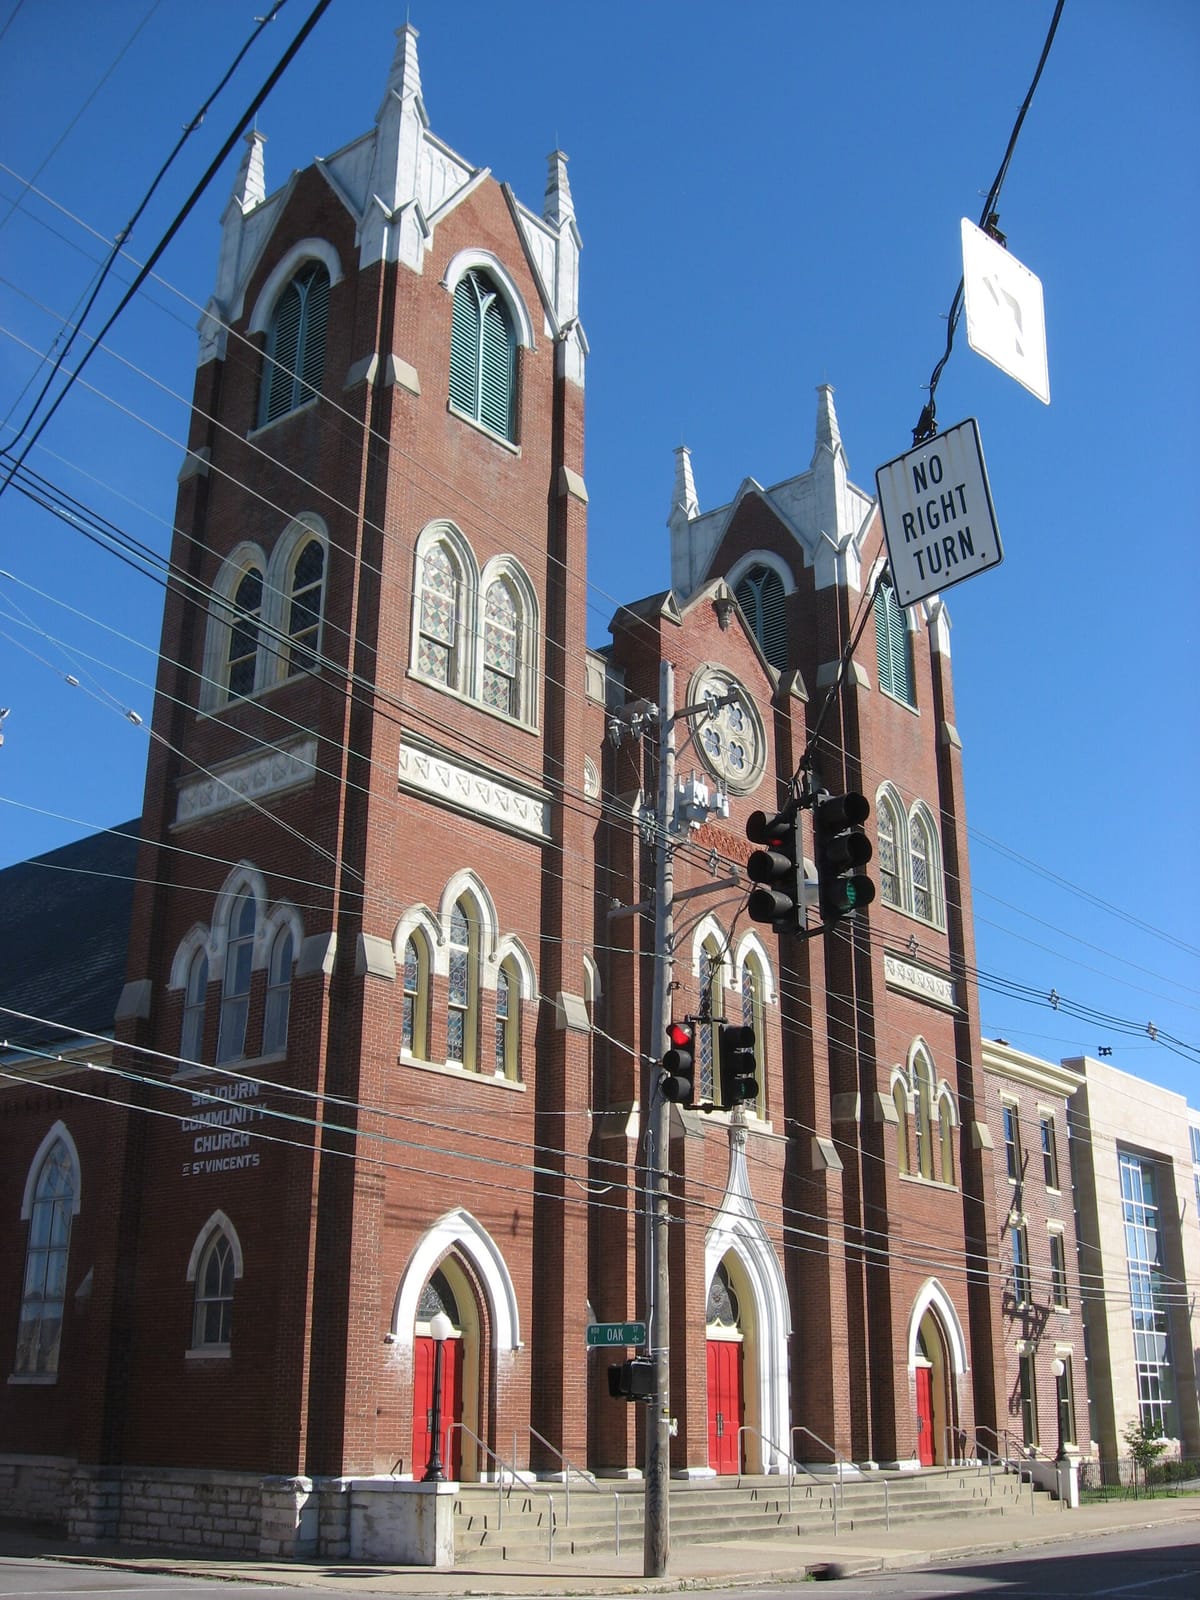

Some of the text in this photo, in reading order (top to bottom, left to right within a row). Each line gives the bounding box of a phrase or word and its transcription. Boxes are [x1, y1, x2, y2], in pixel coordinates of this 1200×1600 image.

[912, 455, 943, 494] NO
[902, 483, 968, 543] RIGHT
[913, 526, 975, 580] TURN
[191, 1082, 260, 1107] SOJOURN
[181, 1101, 267, 1132] COMMUNITY
[193, 1132, 250, 1153] CHURCH
[606, 1328, 624, 1342] OAK
